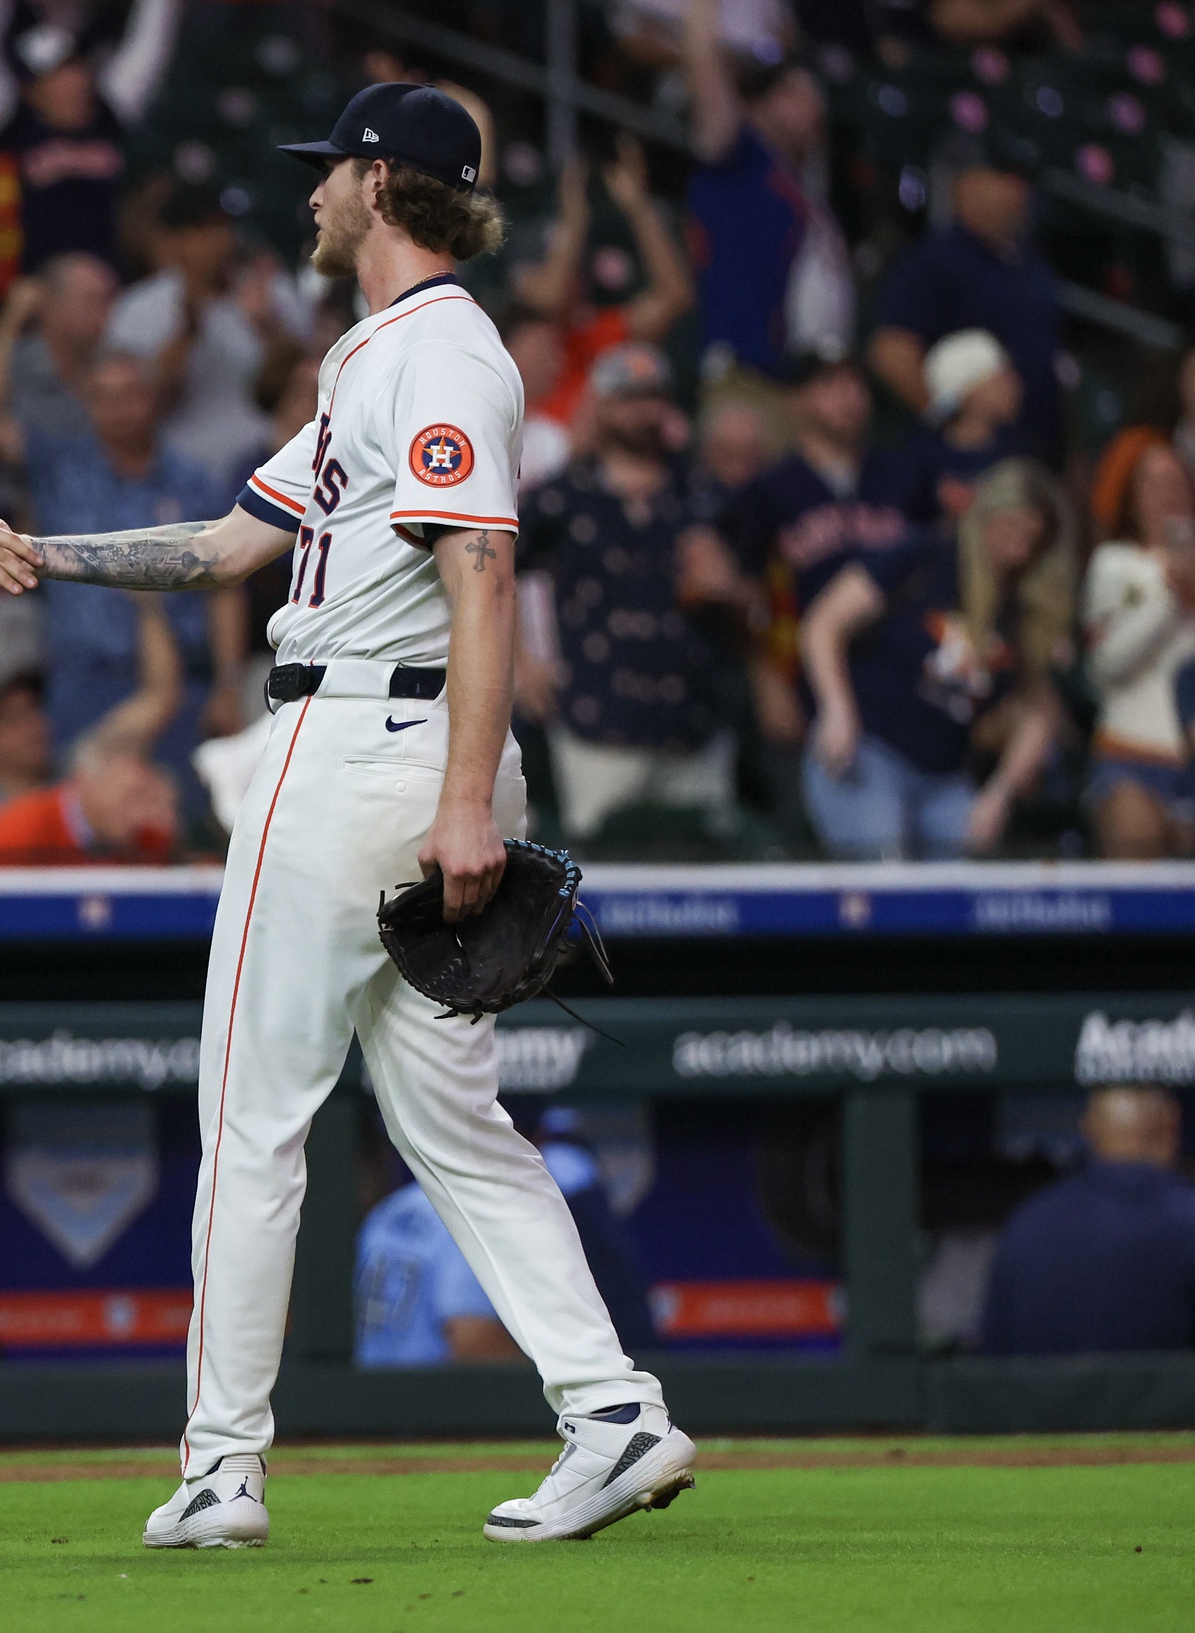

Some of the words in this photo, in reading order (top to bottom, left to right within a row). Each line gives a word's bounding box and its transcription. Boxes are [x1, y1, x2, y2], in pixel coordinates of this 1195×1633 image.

[418, 428, 467, 447] HOUSTON
[428, 445, 454, 468] H
[418, 468, 462, 483] ASTROS
[291, 525, 332, 609] 71
[672, 1019, 997, 1082] academy.com
